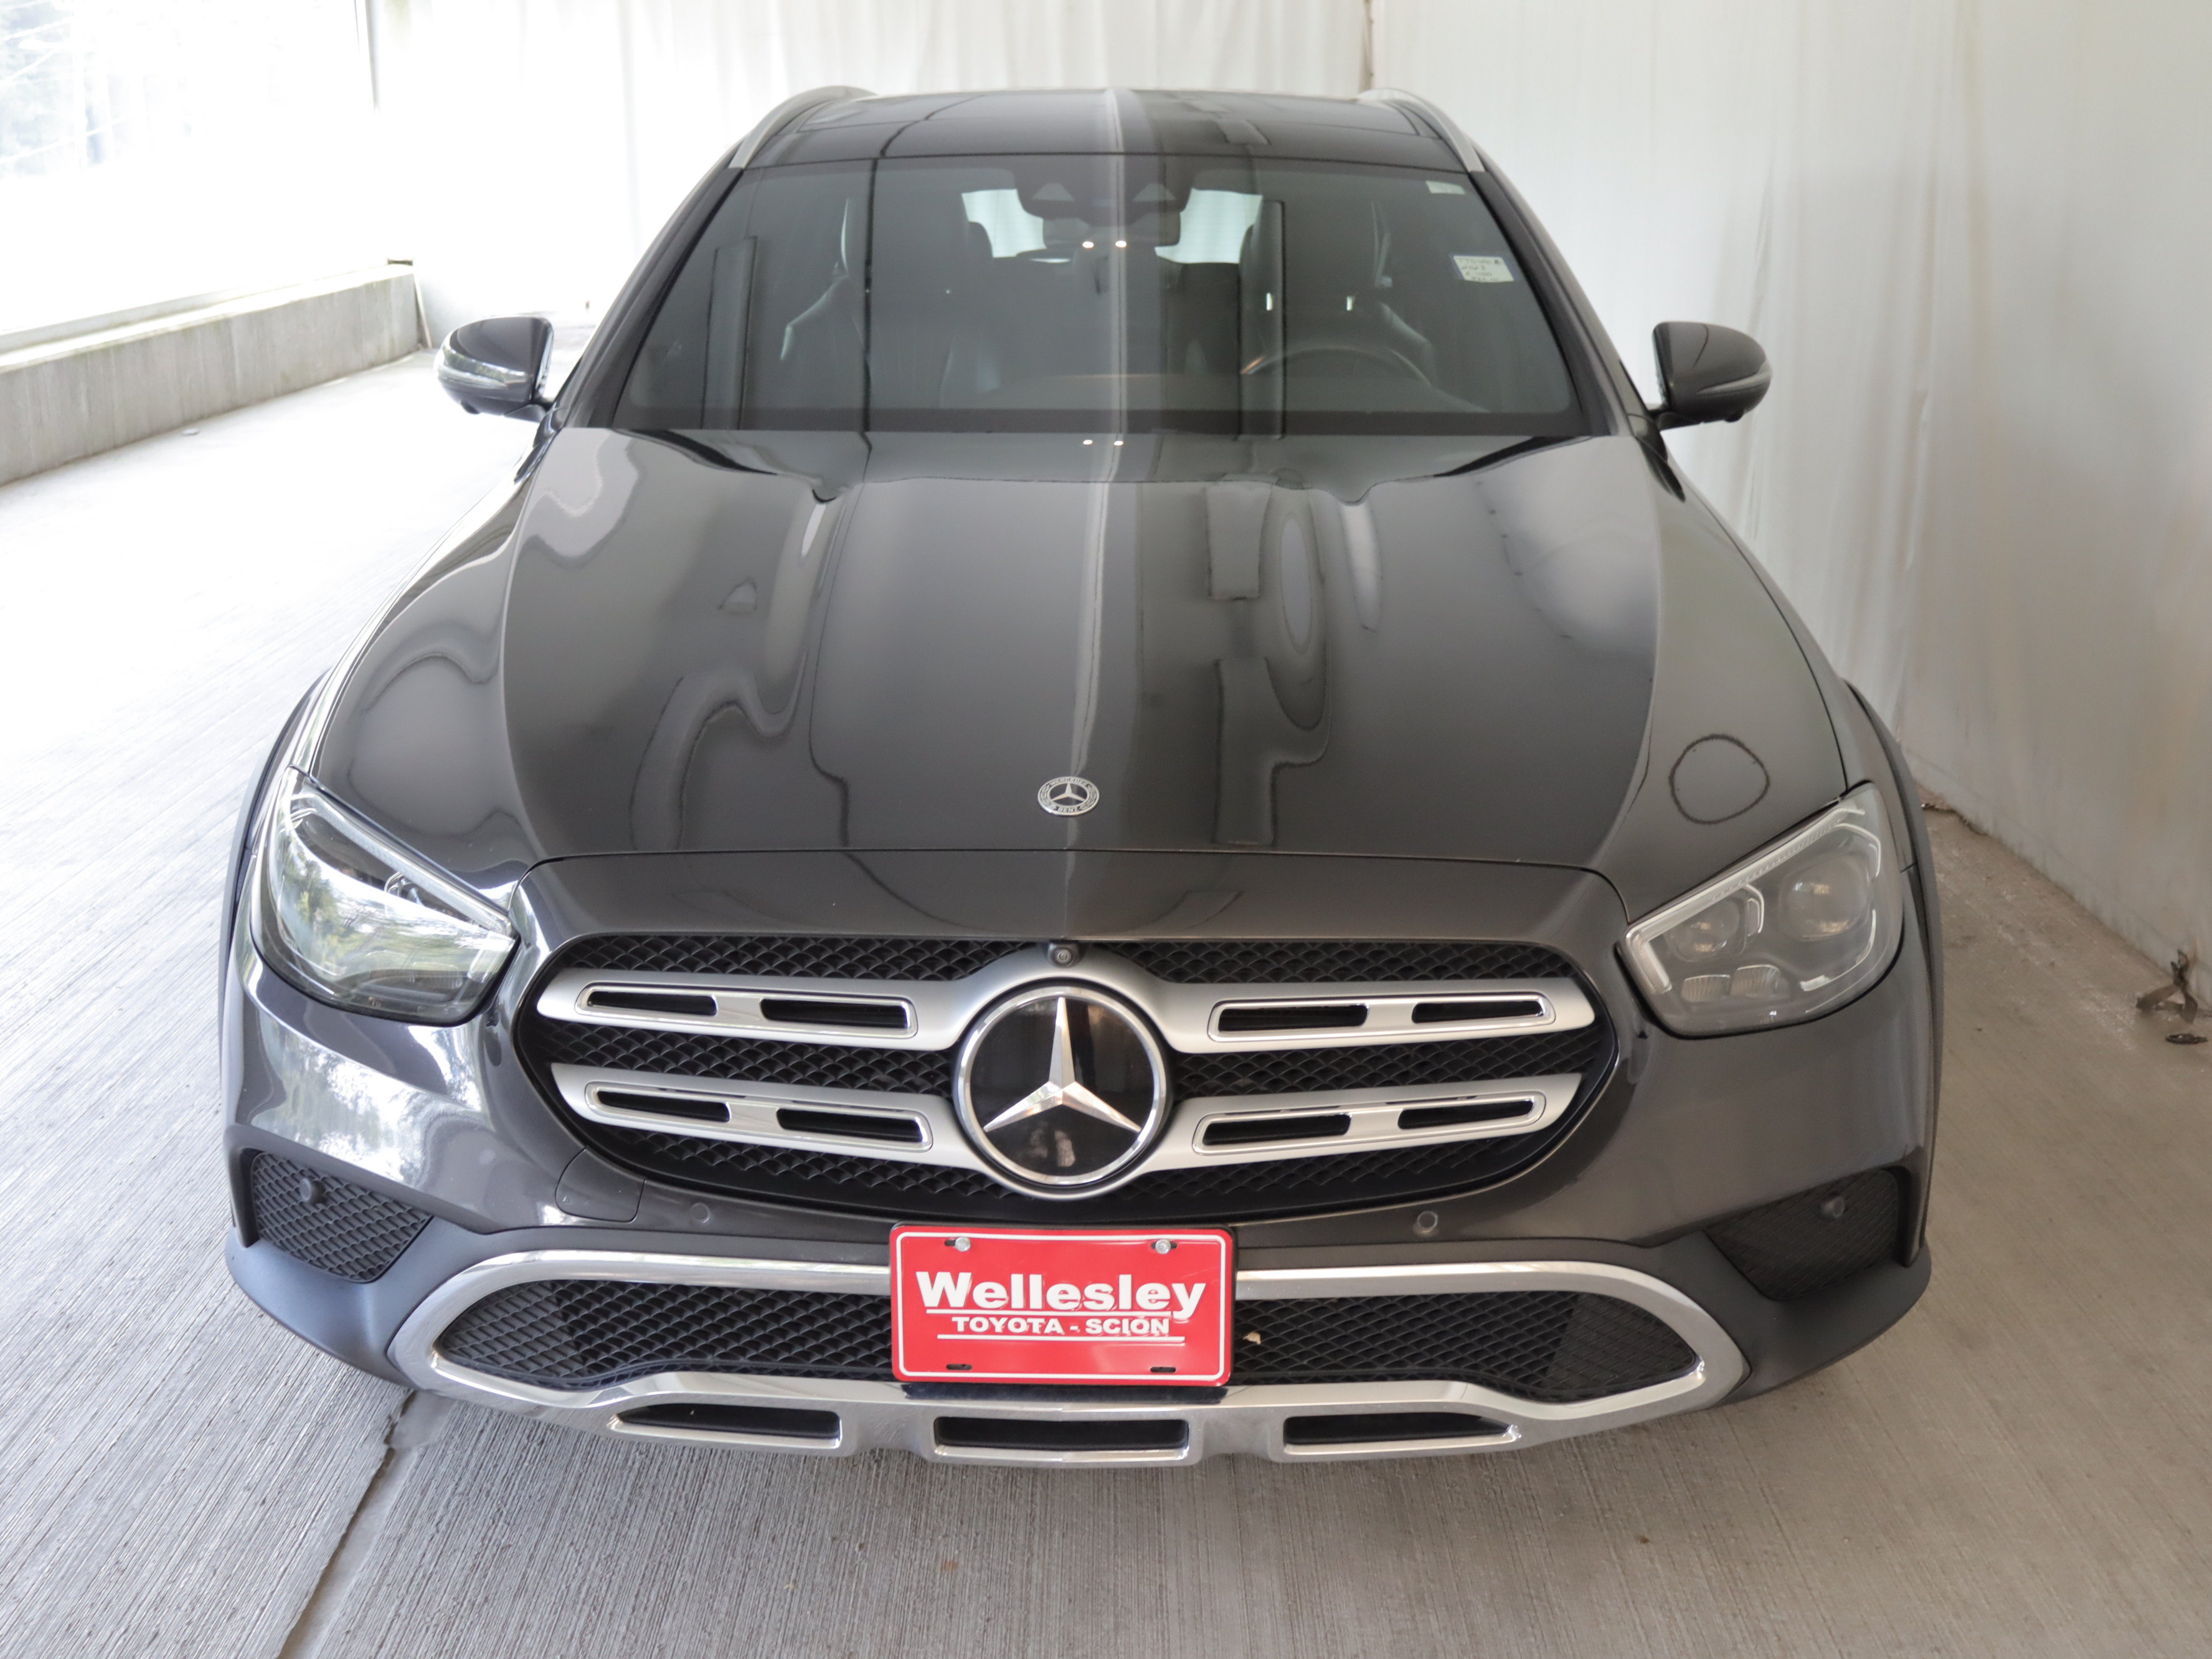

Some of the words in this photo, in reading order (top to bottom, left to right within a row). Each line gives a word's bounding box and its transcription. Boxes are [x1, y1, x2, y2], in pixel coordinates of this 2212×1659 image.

[915, 1271, 1206, 1321] Wellesley
[952, 1316, 1064, 1335] TOYOTA
[1085, 1318, 1170, 1335] SCION
